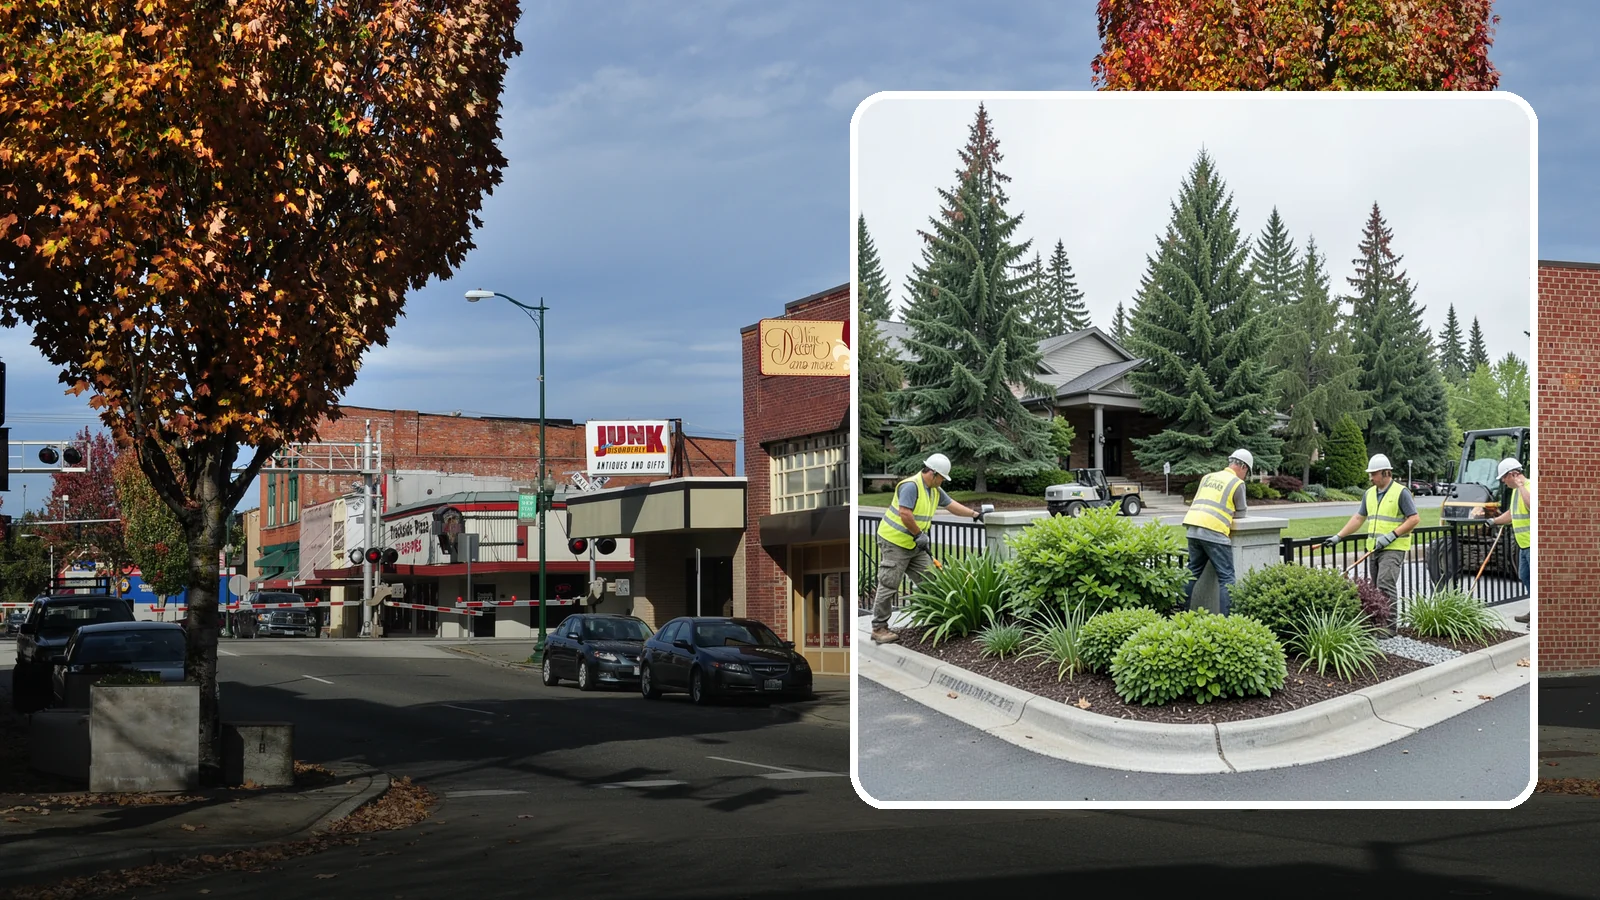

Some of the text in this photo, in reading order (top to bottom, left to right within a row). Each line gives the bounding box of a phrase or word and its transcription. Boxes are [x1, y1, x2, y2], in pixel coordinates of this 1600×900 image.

[595, 426, 664, 457] JUNK
[607, 446, 645, 454] DISORDERLY
[597, 461, 665, 470] ANTIQUES AND GIFTS
[352, 498, 364, 510] CRO
[414, 519, 429, 535] Pizza
